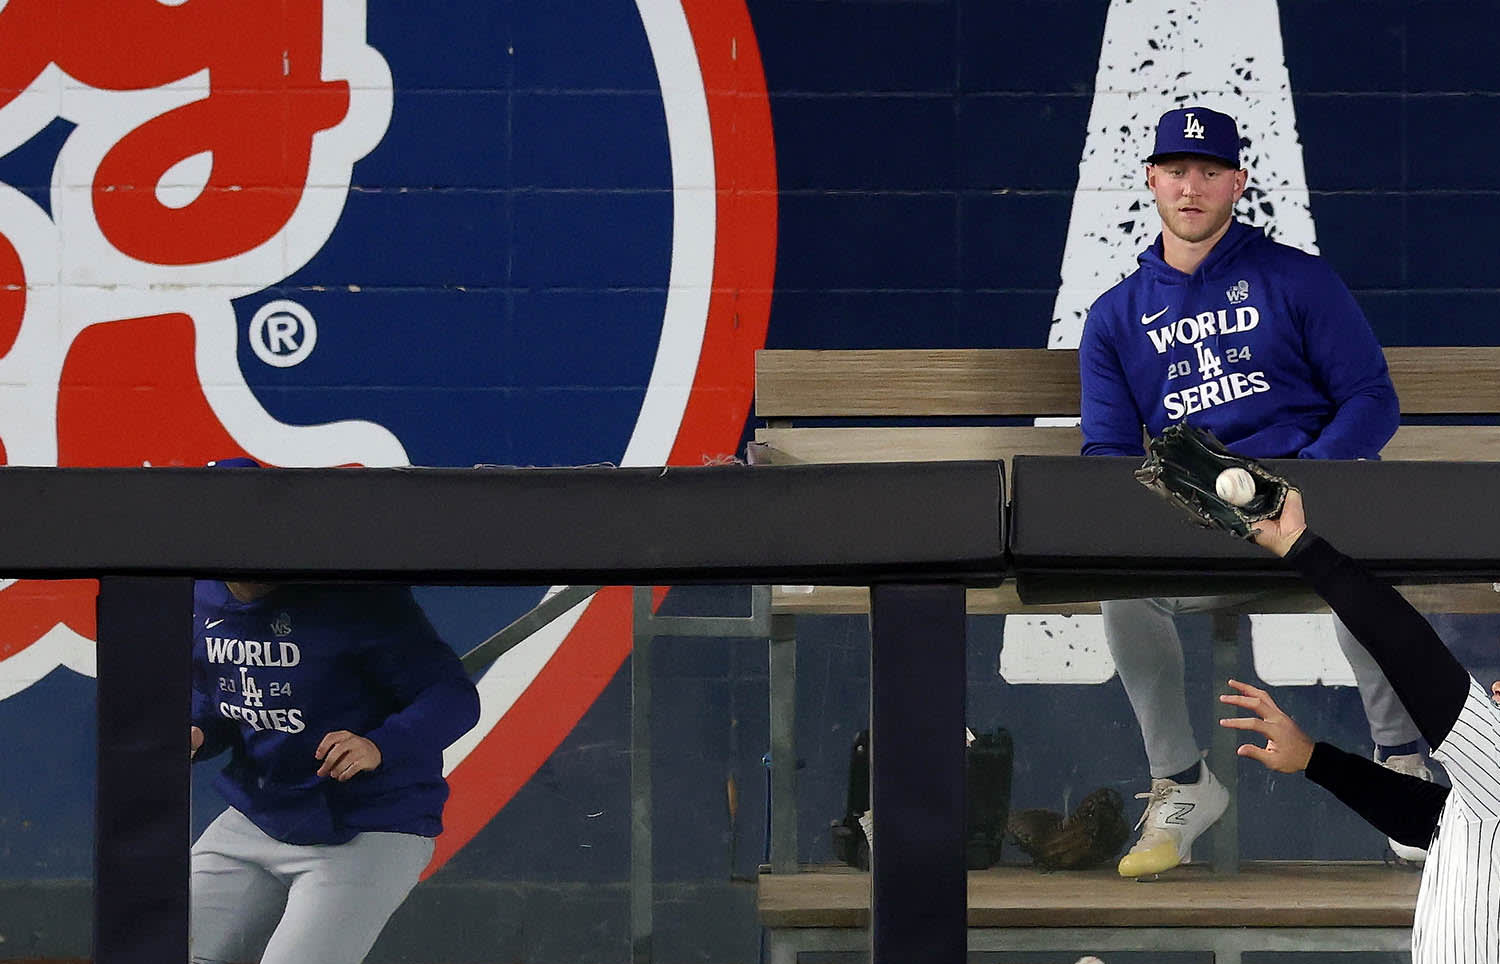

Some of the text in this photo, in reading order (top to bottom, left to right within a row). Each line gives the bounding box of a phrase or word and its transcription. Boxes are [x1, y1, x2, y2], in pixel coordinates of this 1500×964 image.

[1184, 113, 1204, 139] LA
[1146, 306, 1260, 354] WORLD
[1167, 359, 1191, 380] 20
[1226, 346, 1252, 364] 24
[1163, 371, 1271, 420] SERIES
[205, 637, 301, 667] WORLD
[269, 682, 292, 697] 24
